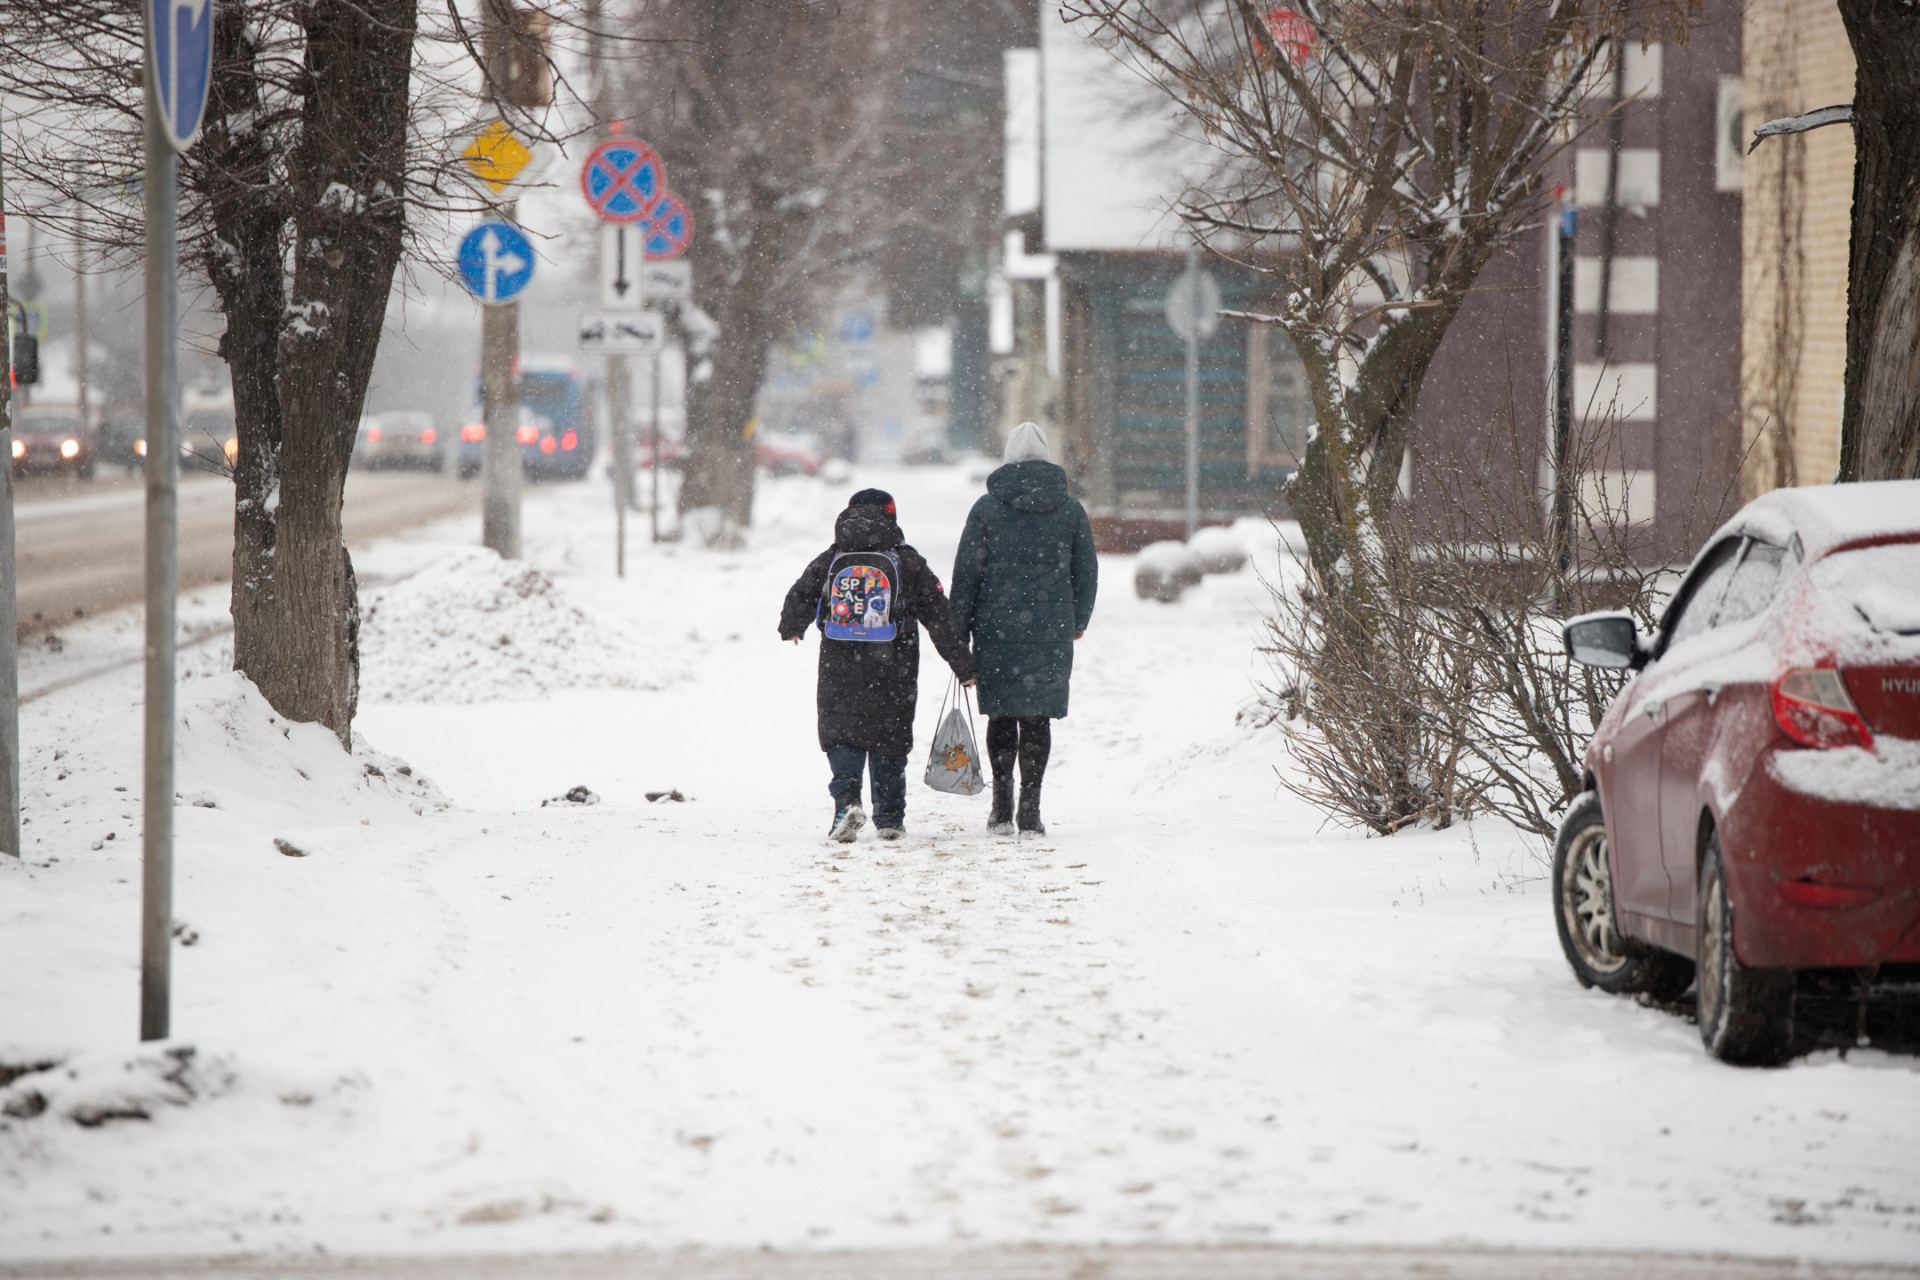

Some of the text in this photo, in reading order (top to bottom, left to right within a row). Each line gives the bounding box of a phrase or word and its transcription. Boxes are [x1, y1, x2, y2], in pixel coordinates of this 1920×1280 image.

[840, 578, 860, 591] SP
[854, 602, 864, 615] E
[1881, 678, 1920, 693] HYU
